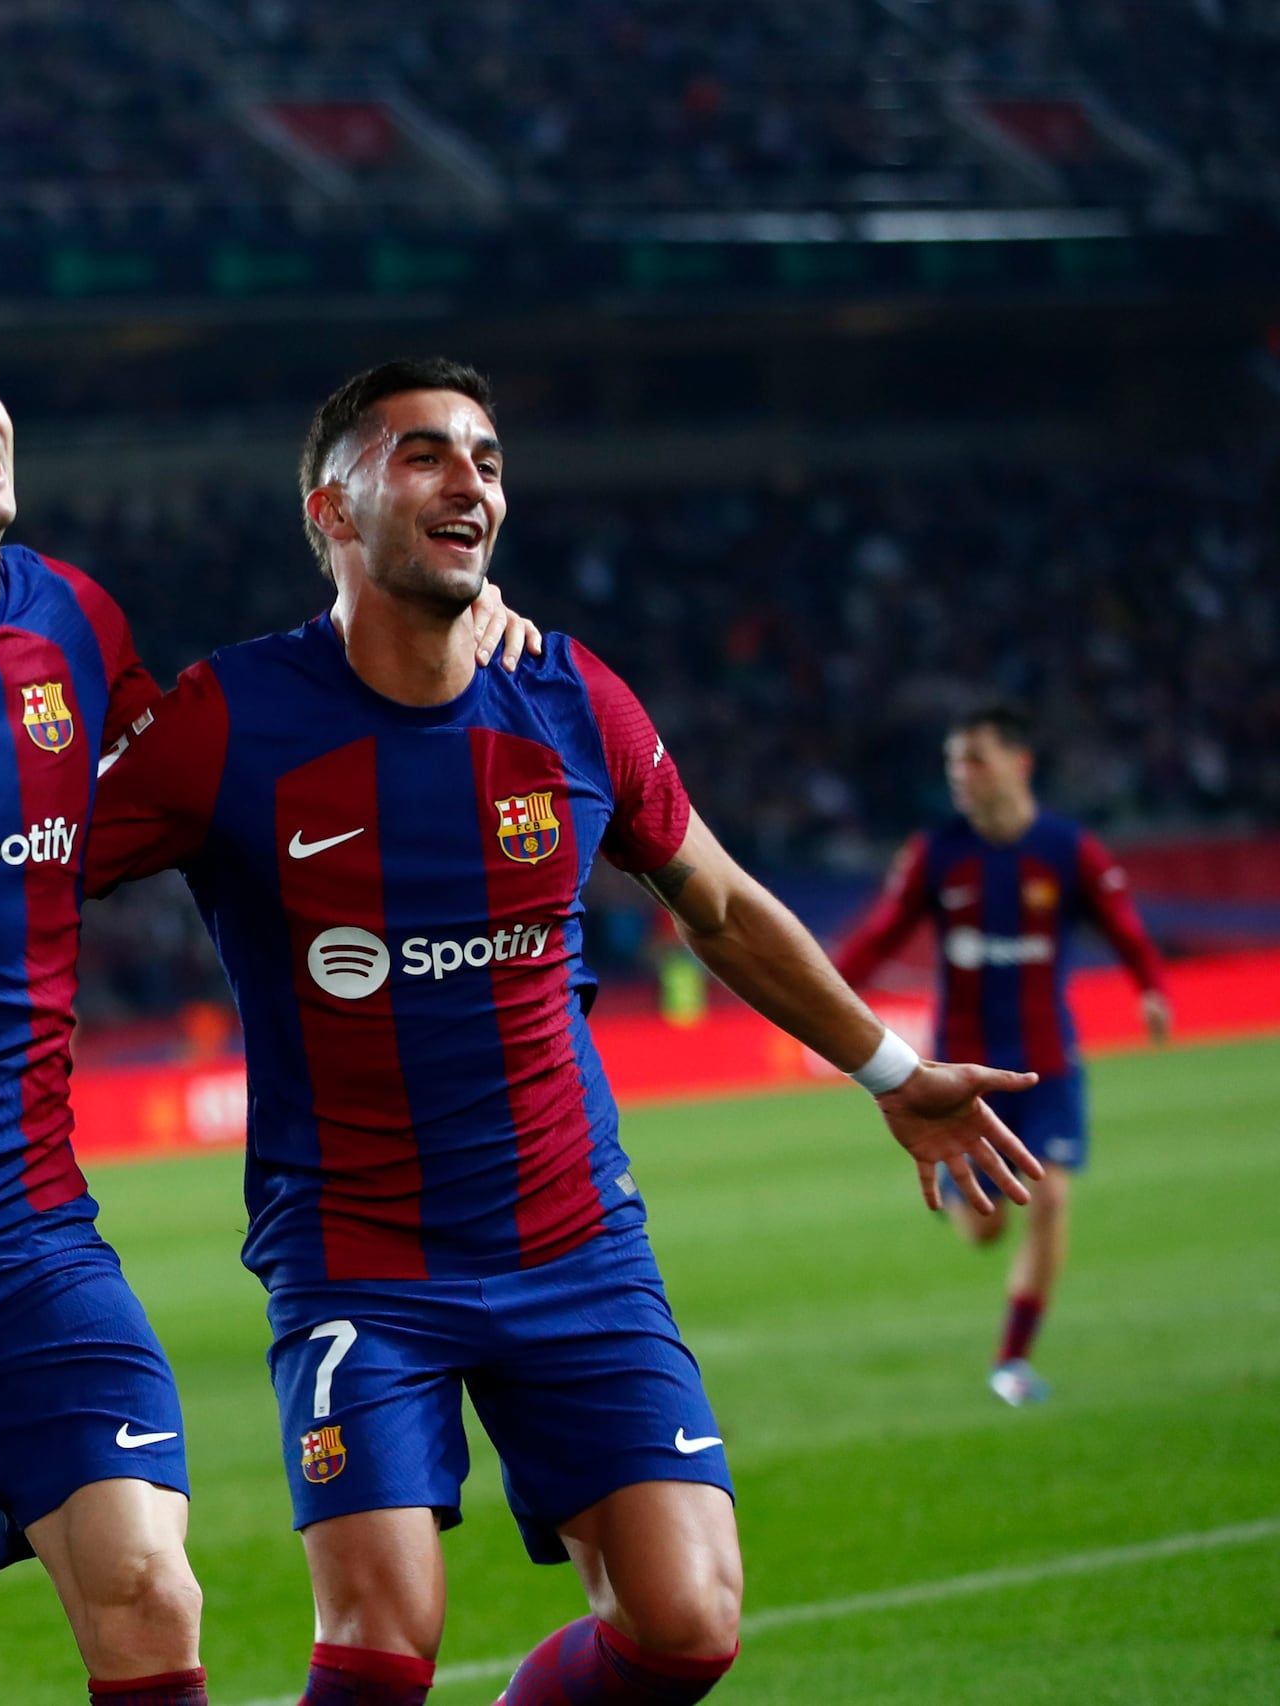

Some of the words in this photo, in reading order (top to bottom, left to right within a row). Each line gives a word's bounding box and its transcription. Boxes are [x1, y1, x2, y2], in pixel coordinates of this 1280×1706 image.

[36, 711, 58, 722] FCB
[516, 821, 541, 834] FCB
[401, 923, 553, 981] Spotify
[308, 1319, 359, 1419] 7
